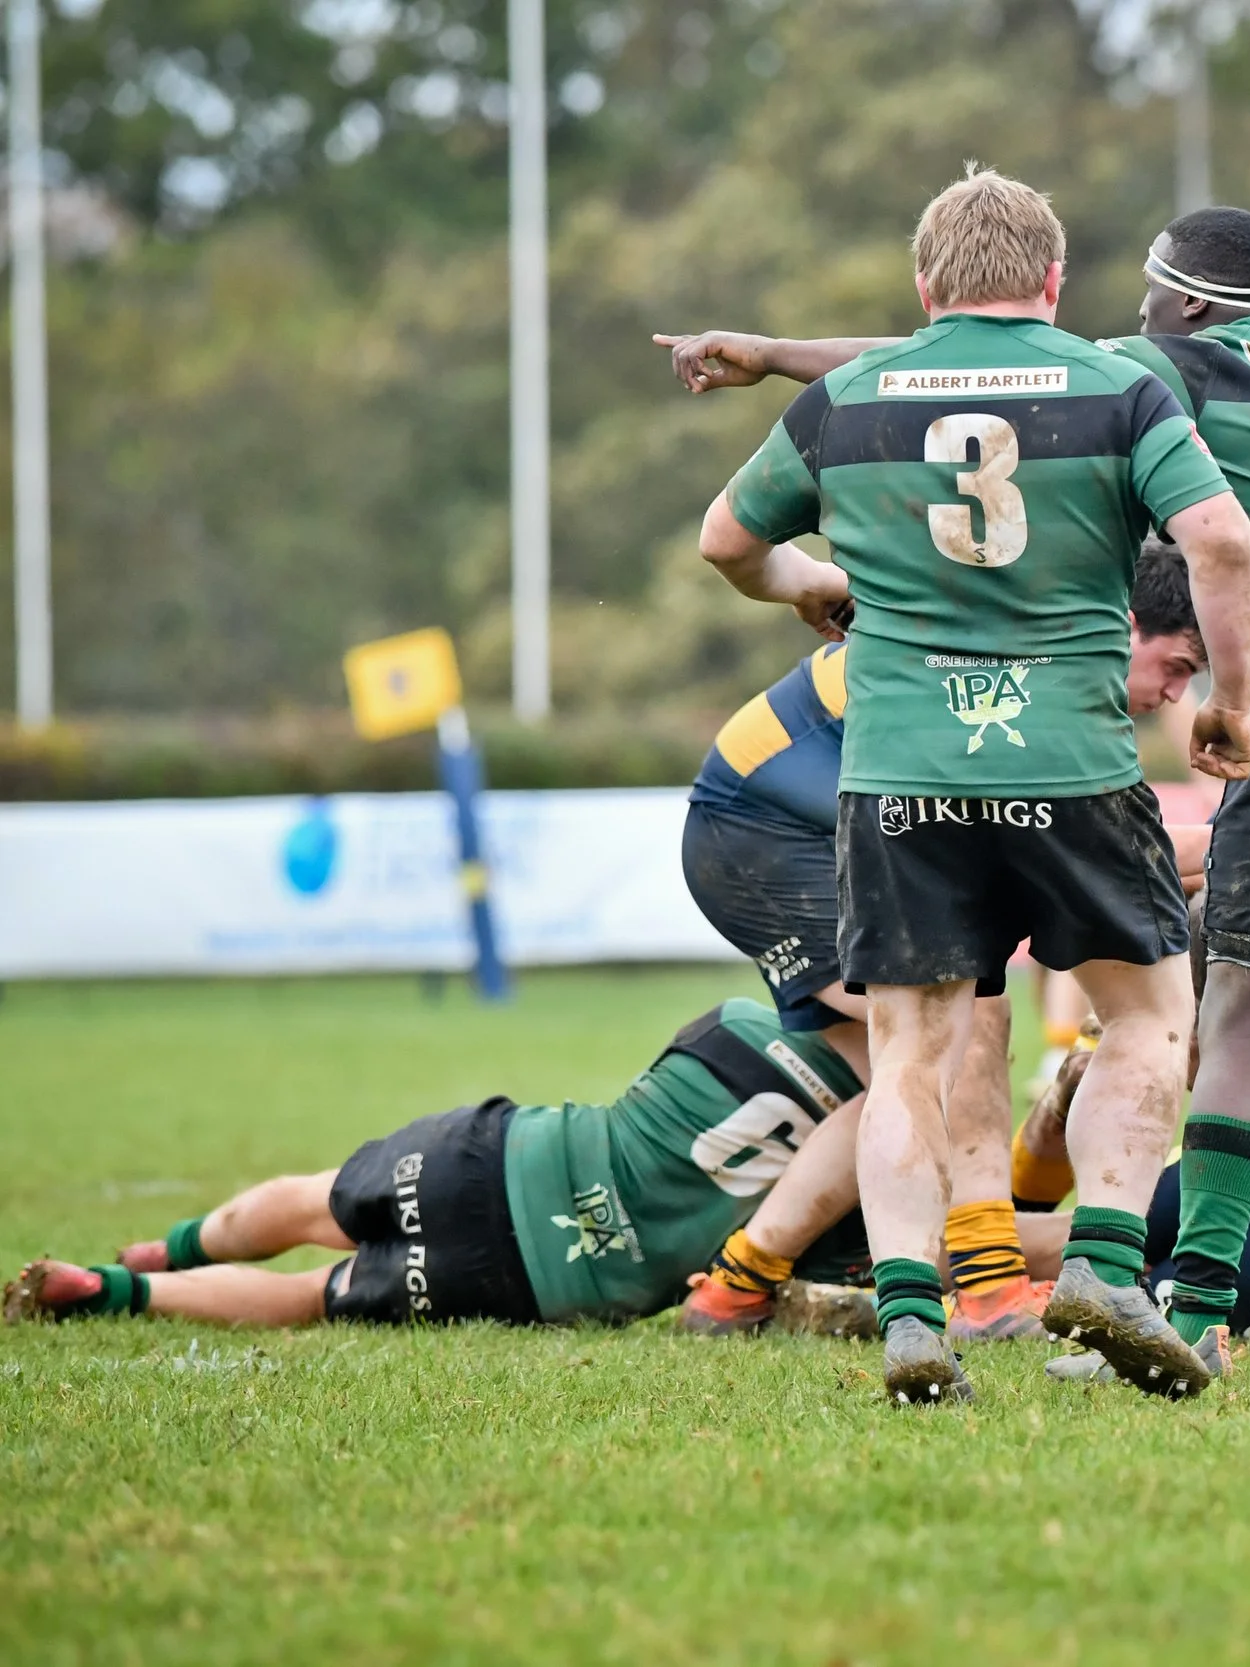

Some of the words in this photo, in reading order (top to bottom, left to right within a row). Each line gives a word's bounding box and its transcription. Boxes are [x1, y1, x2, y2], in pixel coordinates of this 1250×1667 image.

[906, 375, 972, 389] ALBERT
[977, 372, 1063, 388] BARTLETT
[924, 413, 1028, 568] 3
[925, 654, 999, 668] GREENE
[946, 669, 1031, 714] IPA
[573, 1186, 622, 1260] IPA
